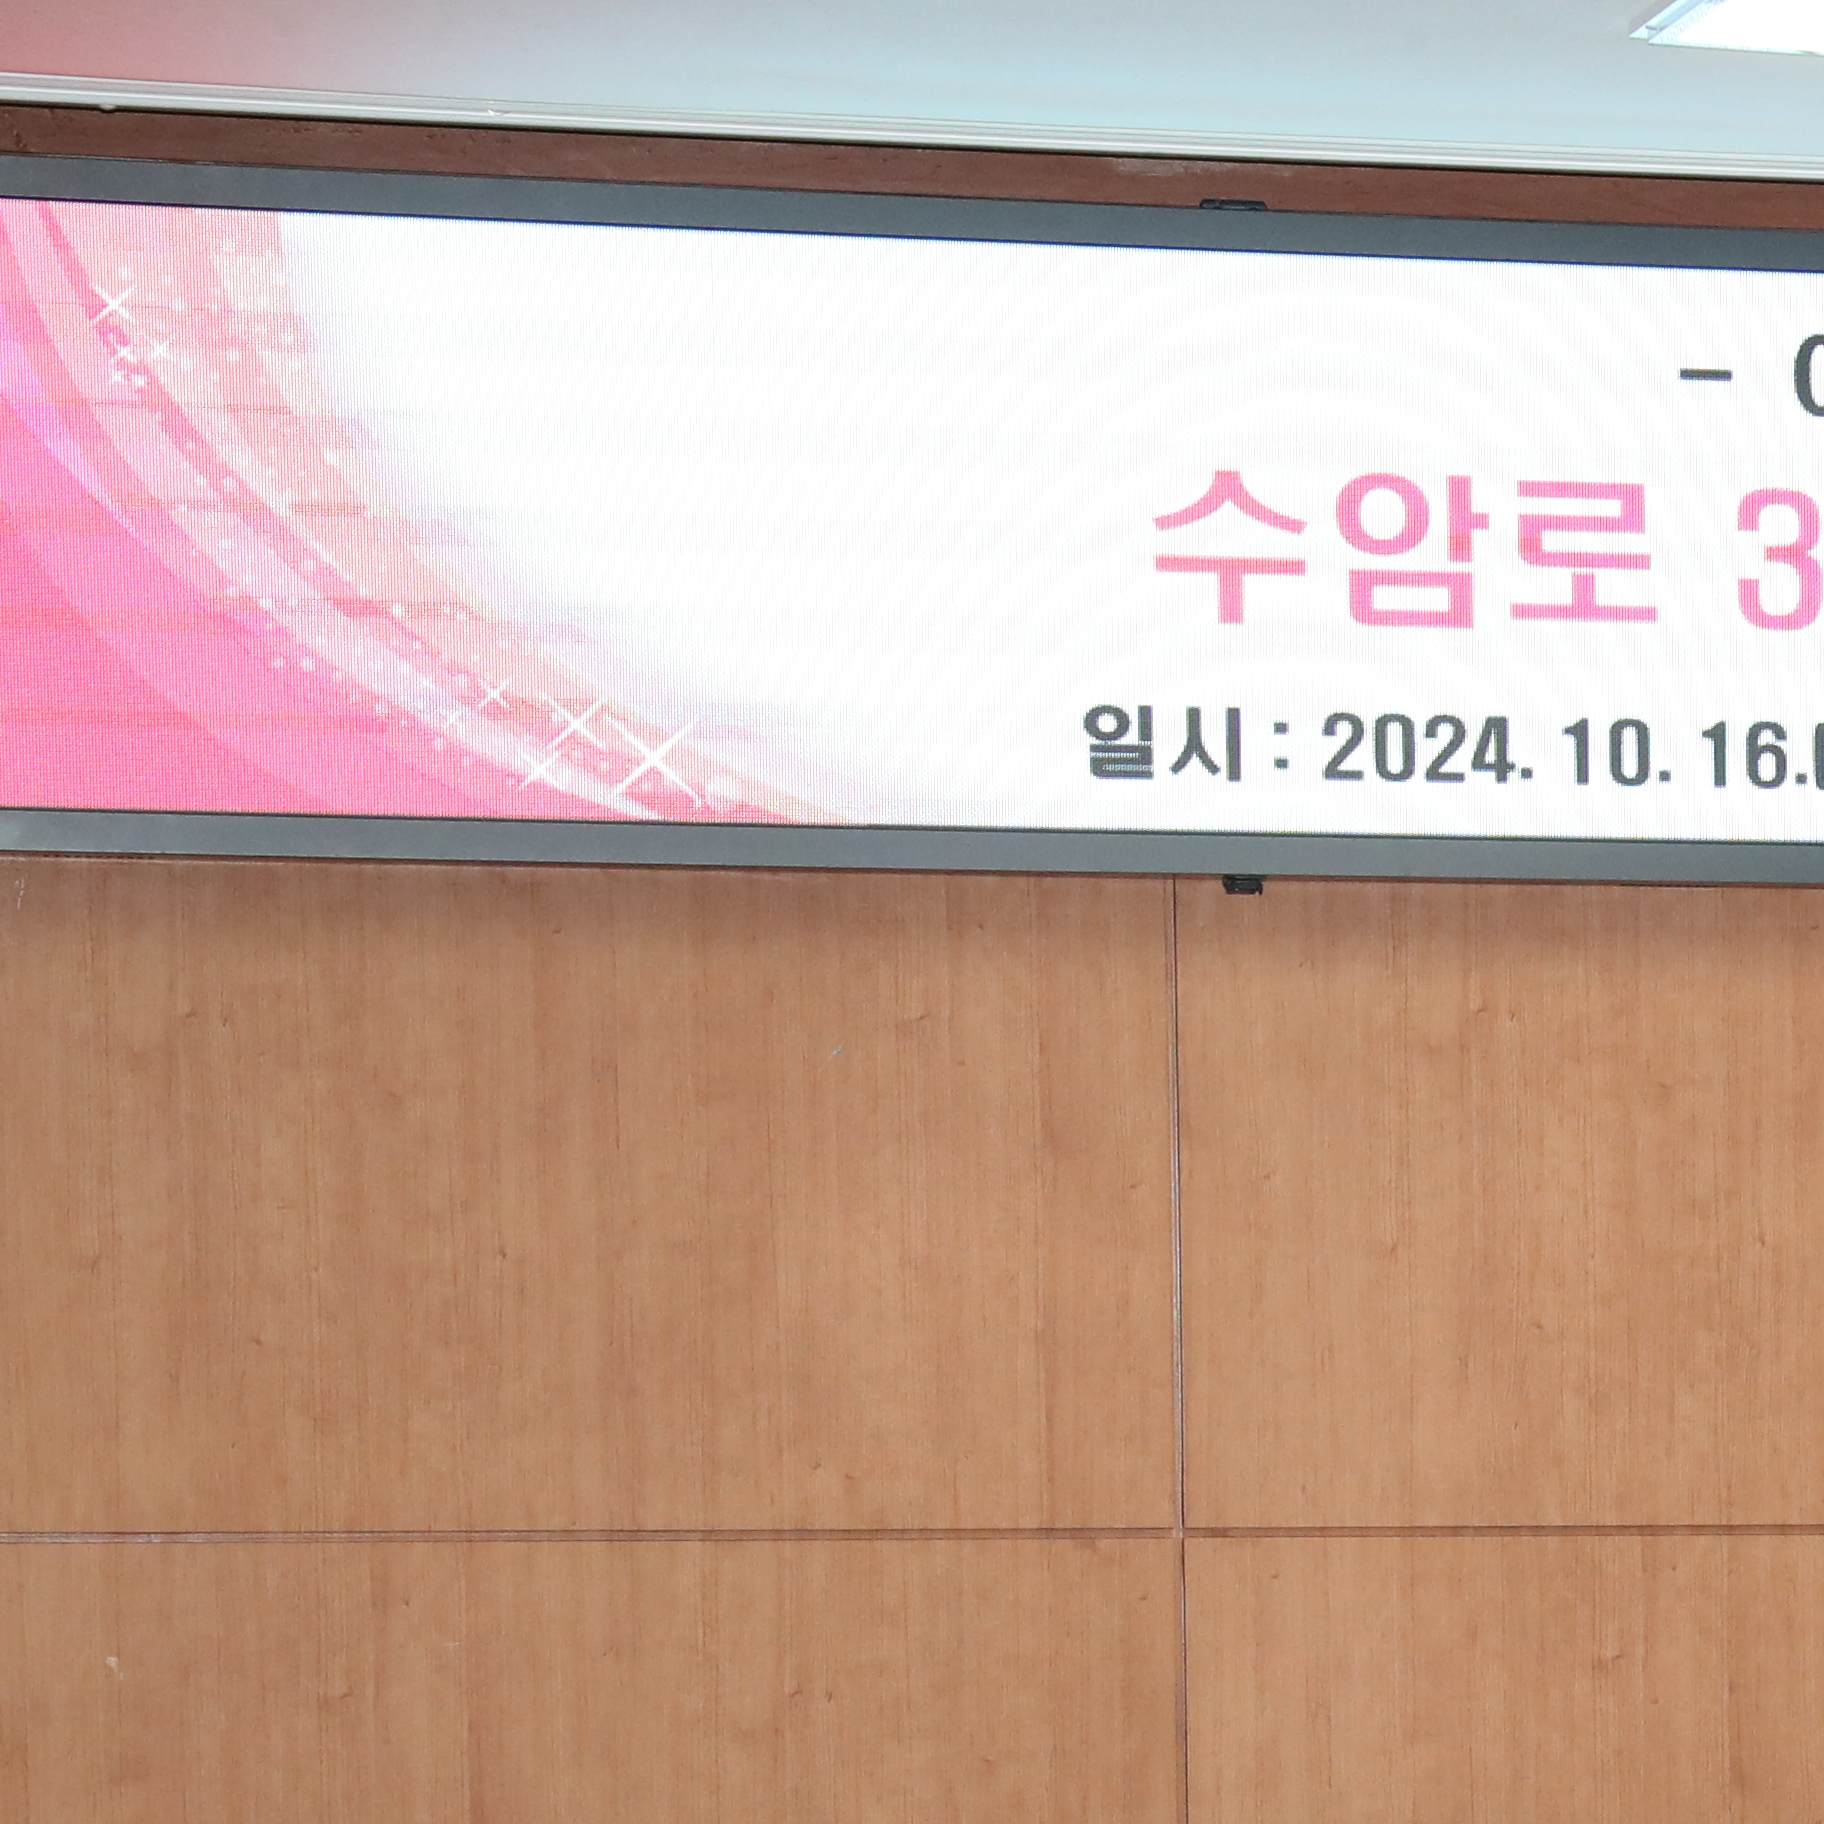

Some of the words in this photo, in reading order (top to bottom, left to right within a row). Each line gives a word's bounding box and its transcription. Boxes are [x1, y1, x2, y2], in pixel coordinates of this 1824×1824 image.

[1153, 469, 1659, 630] 수암로
[1081, 703, 1243, 784] 일시
[1321, 710, 1534, 785] 2024.
[1562, 716, 1672, 789] 10.
